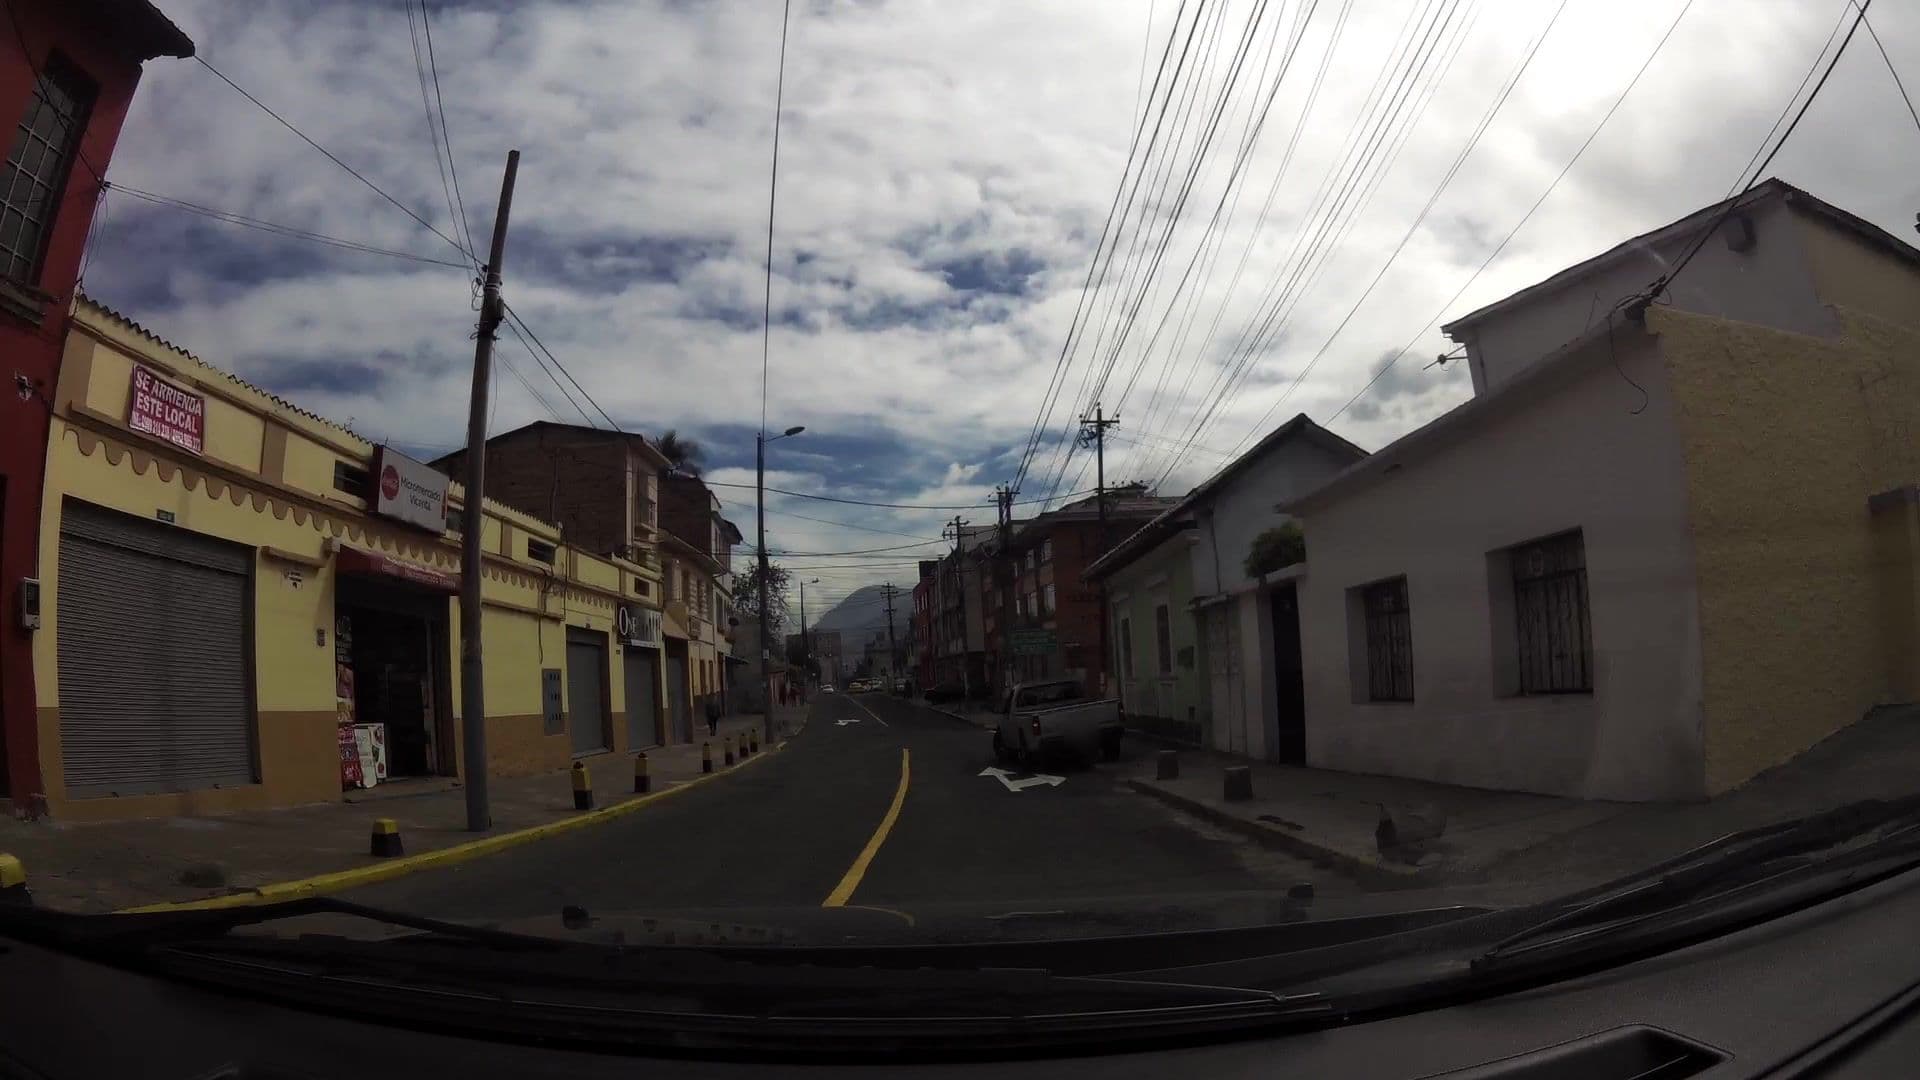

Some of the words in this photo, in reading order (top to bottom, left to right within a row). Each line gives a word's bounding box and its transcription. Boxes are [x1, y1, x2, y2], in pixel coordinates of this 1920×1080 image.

[136, 371, 151, 393] SE
[152, 380, 202, 416] ARRIENDA
[136, 392, 163, 418] ESTE
[165, 405, 198, 434] LOCAL
[400, 476, 441, 501] Micromercado
